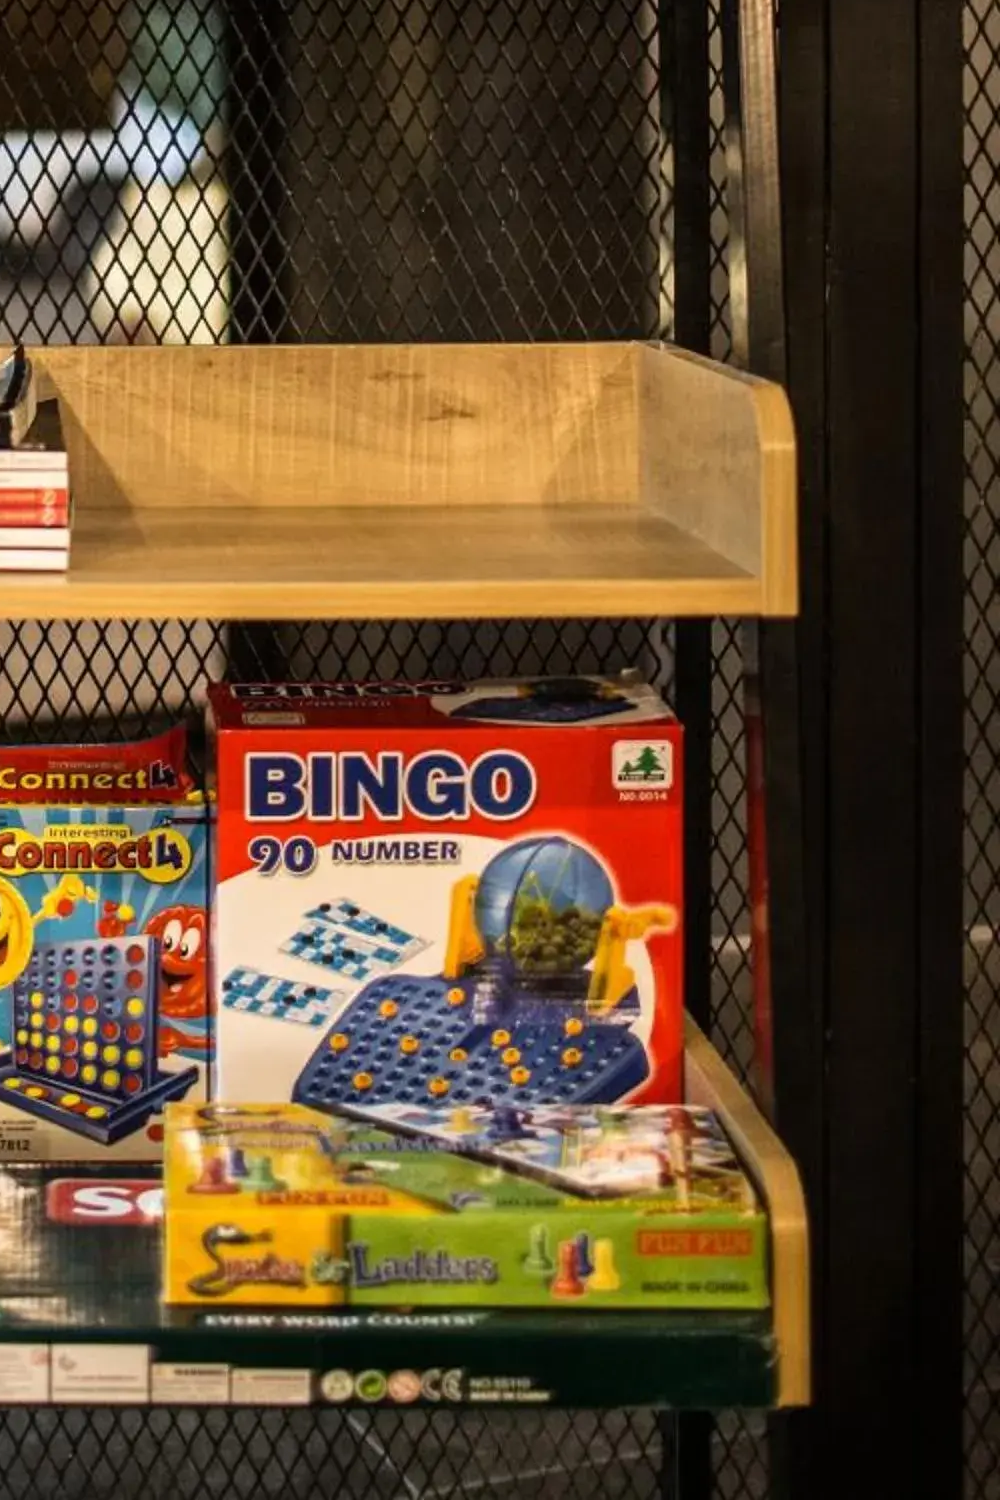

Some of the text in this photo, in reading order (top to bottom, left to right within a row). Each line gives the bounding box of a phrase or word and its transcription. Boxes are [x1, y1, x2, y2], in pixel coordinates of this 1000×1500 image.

[244, 750, 535, 821] BINGO
[249, 836, 459, 874] 90 NUMBER
[348, 1240, 498, 1288] Ladders
[205, 1314, 275, 1327] EVERY
[281, 1315, 360, 1328] WORD
